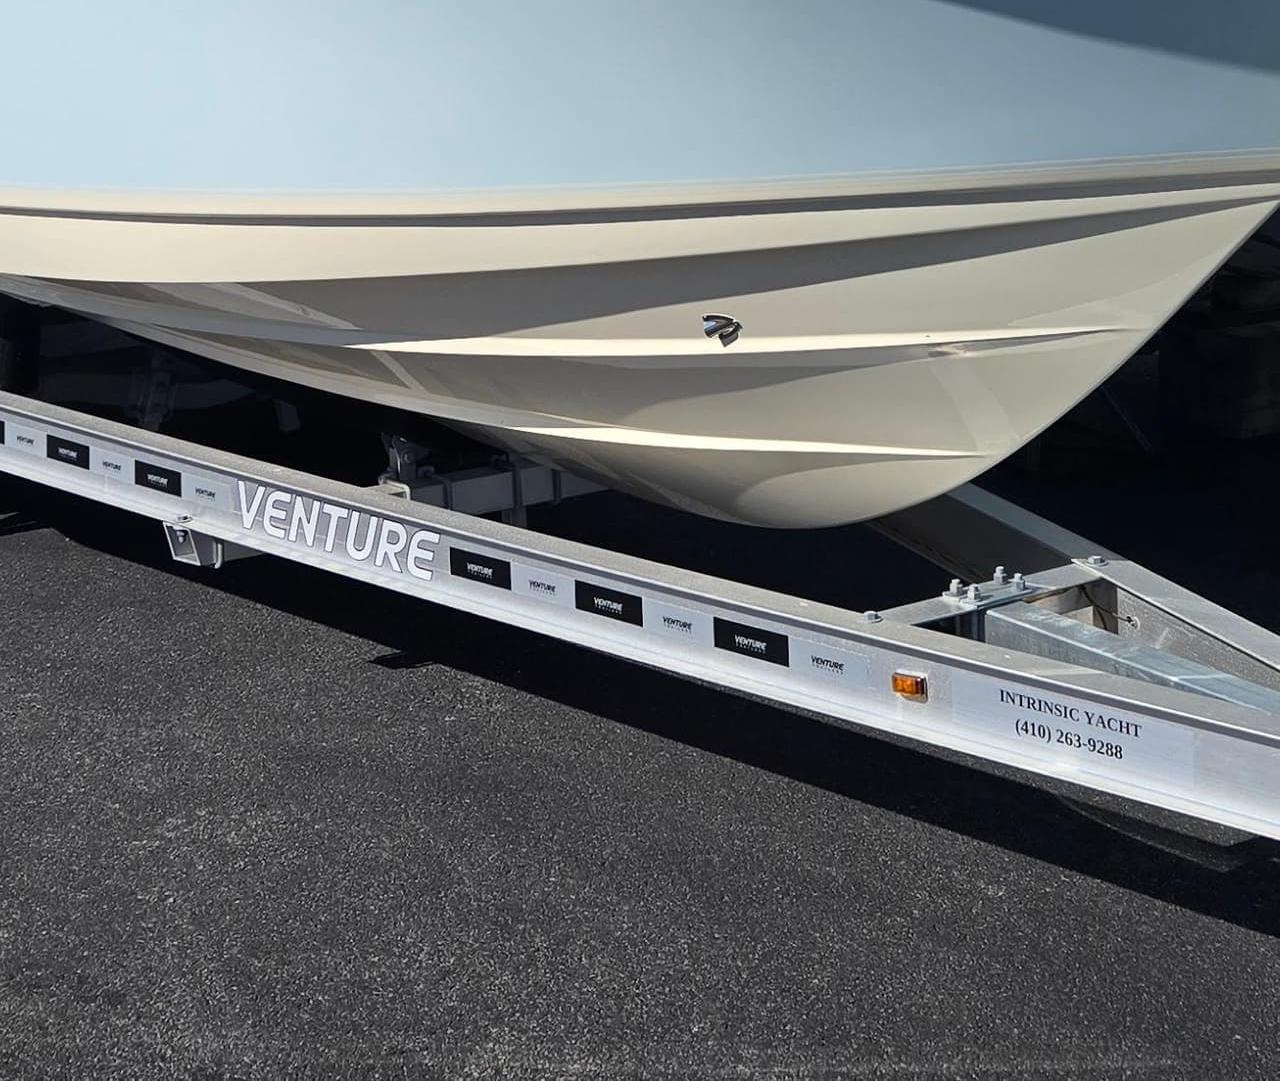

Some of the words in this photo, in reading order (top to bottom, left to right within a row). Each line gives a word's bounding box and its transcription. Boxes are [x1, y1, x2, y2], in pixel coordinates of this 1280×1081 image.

[237, 479, 441, 582] VENTURE
[528, 579, 556, 593] VENTURE
[662, 615, 692, 631] VENTURE
[734, 634, 768, 652] VENTURE
[810, 654, 845, 671] VENTURE
[999, 688, 1080, 722] INTRINSIC
[1084, 709, 1142, 738] YACHT
[1014, 718, 1052, 744] (410)
[1055, 729, 1124, 760] 263-9288
